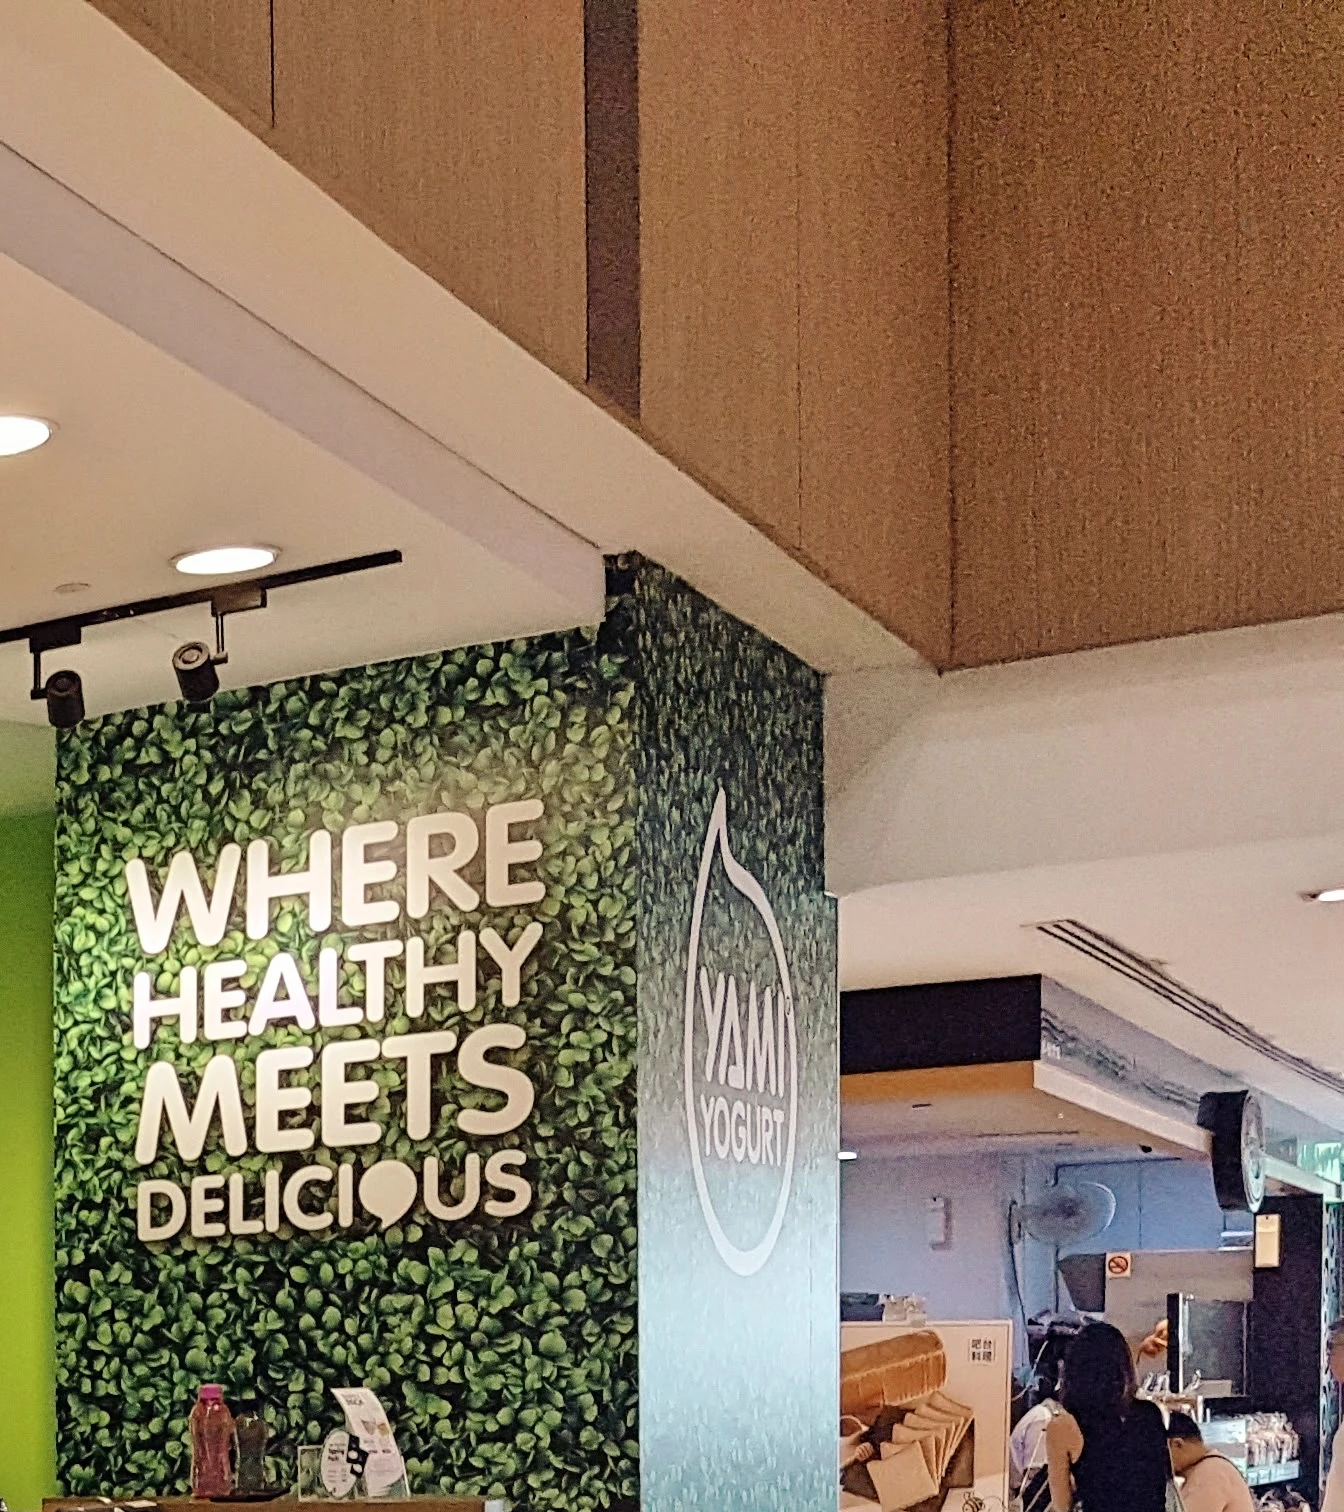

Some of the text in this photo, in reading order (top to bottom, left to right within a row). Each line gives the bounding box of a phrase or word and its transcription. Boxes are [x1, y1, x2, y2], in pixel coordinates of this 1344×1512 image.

[124, 798, 547, 955] WHERE
[132, 921, 544, 1050] HEALTHY
[700, 965, 786, 1099] YAMI
[134, 1022, 536, 1165] MEETS
[699, 1093, 785, 1167] YOGURT
[136, 1149, 533, 1243] DELICIOUS
